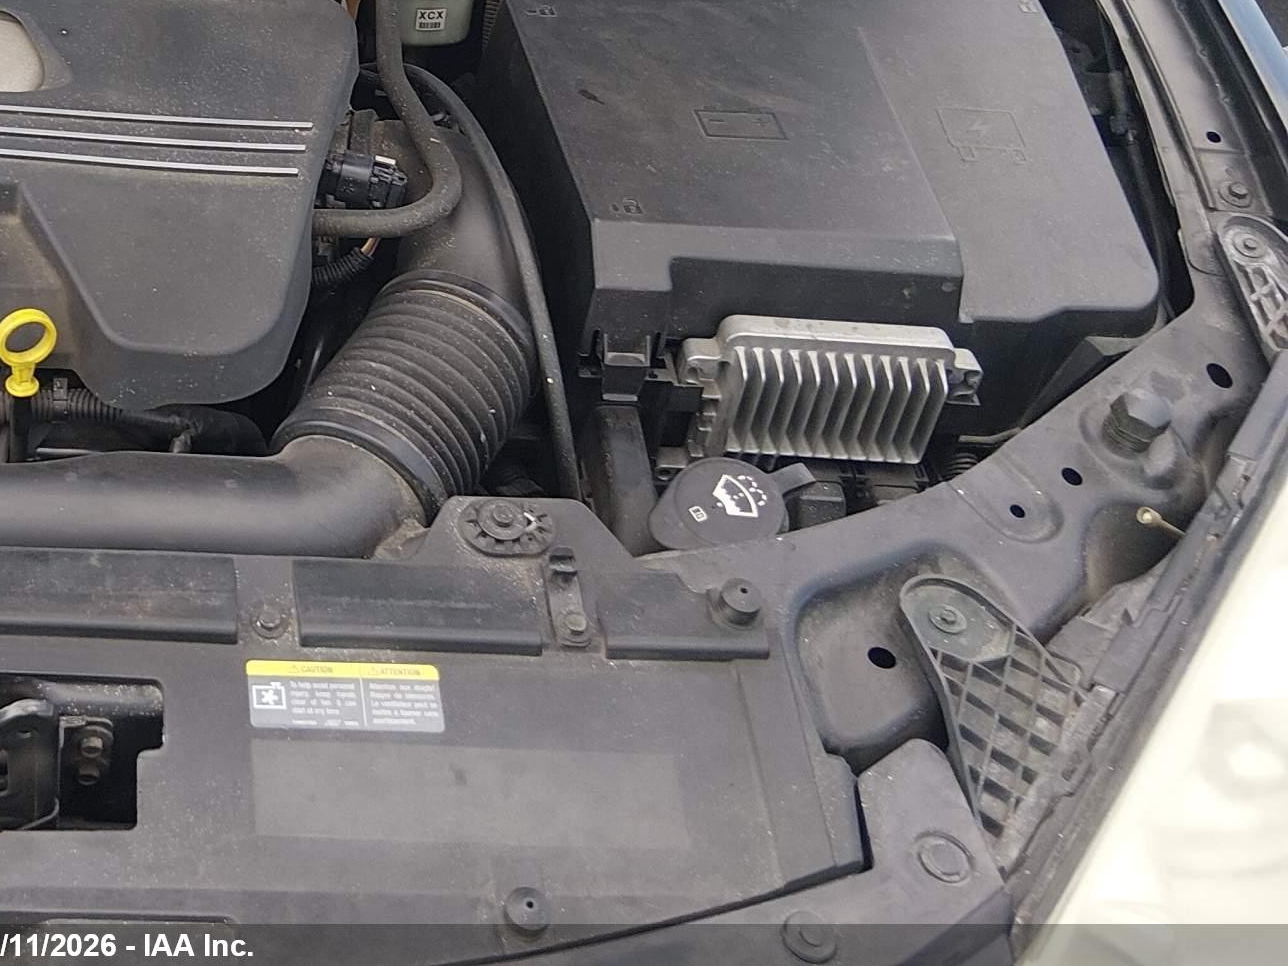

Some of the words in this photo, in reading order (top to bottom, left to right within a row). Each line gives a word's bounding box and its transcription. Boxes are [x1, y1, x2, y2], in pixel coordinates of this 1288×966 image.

[418, 10, 444, 20] XCX
[300, 666, 334, 674] CAUTION
[379, 667, 421, 676] ATTENTION
